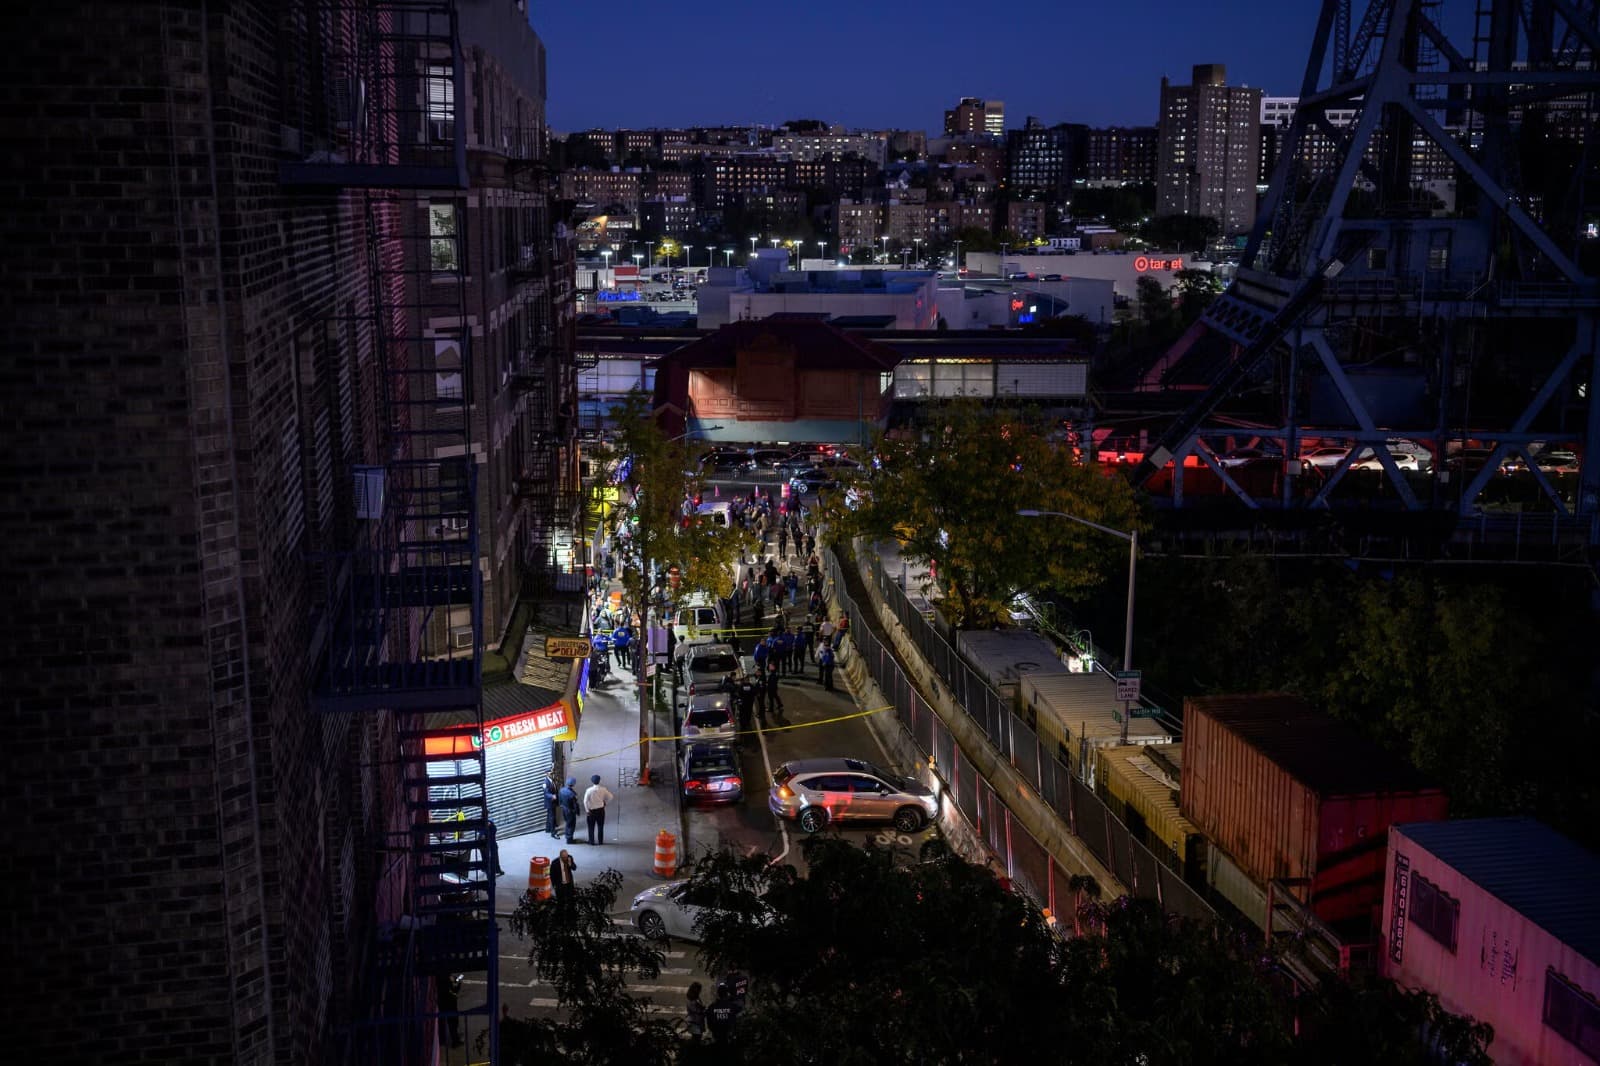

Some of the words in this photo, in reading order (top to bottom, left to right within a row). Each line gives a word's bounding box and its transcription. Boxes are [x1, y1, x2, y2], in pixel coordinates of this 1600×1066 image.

[561, 648, 577, 656] DELI
[503, 718, 536, 739] FRESH
[537, 709, 563, 729] MEAT
